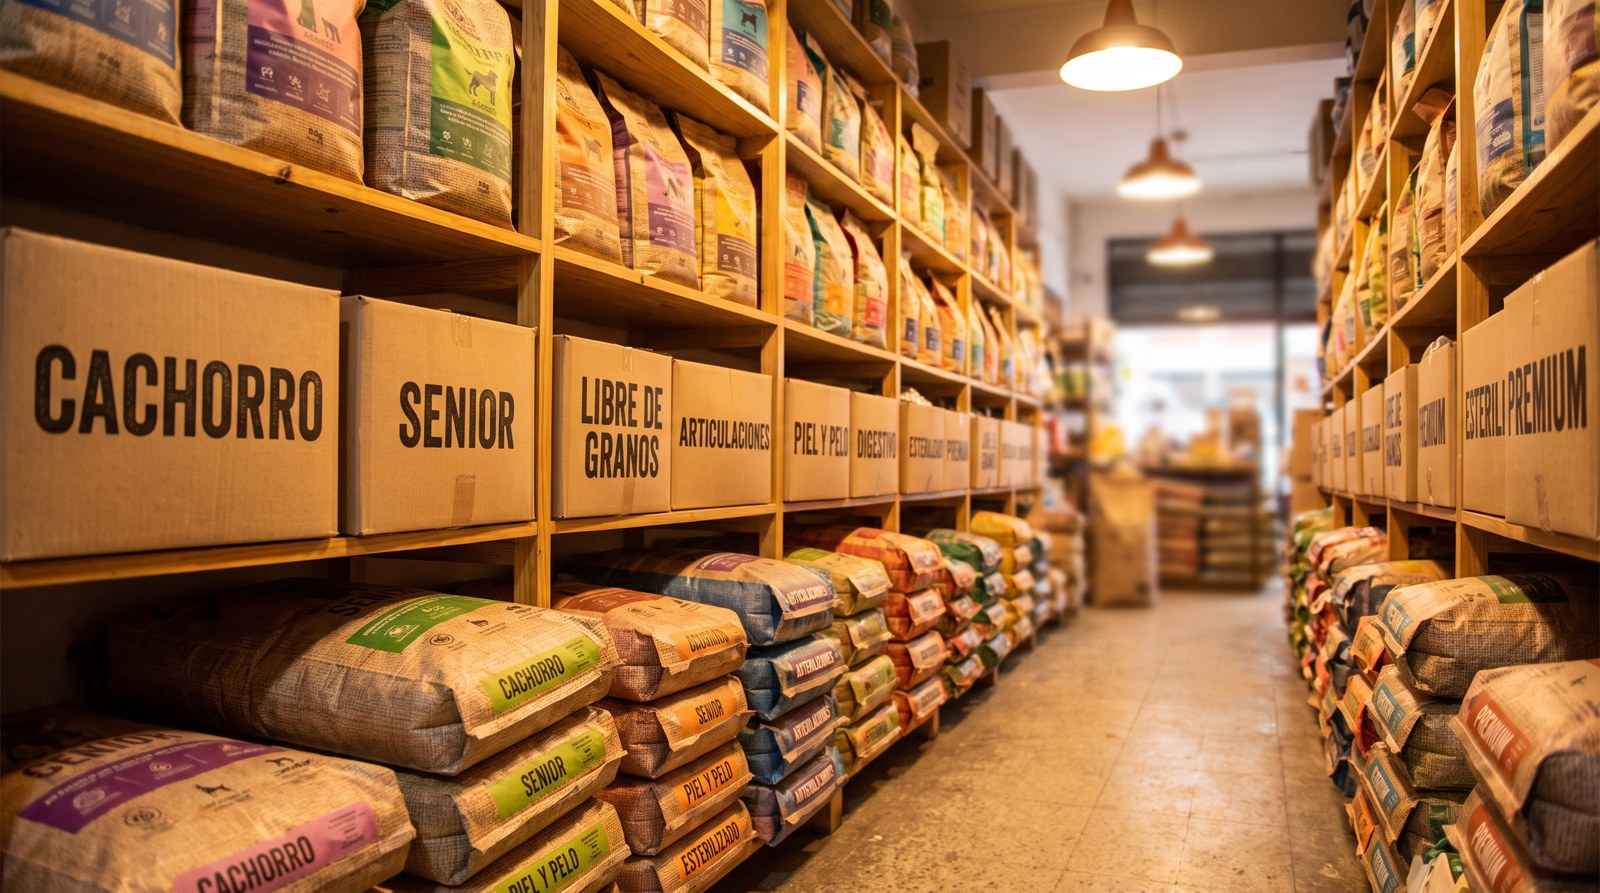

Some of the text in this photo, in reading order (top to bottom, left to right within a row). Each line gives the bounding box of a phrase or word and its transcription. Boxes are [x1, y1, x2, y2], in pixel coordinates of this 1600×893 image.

[35, 344, 323, 442] CACHORRO
[581, 376, 663, 430] LIBRE DE
[1465, 379, 1506, 440] ESTERILI
[1508, 344, 1587, 437] PREMIUM
[399, 381, 515, 449] SENIOR
[679, 416, 770, 451] ARTICULACIONES
[584, 430, 660, 479] GRANOS
[794, 421, 849, 457] PIEL Y PELO
[857, 429, 897, 459] DIGESTIVO
[498, 654, 565, 700] CACHORRO
[695, 699, 724, 725] SENIOR
[521, 755, 567, 798] SENIOR
[683, 761, 733, 805] PIEL Y PELO
[537, 865, 549, 889] Y
[548, 847, 580, 883] PELO
[681, 821, 740, 876] ESTERILIZADO
